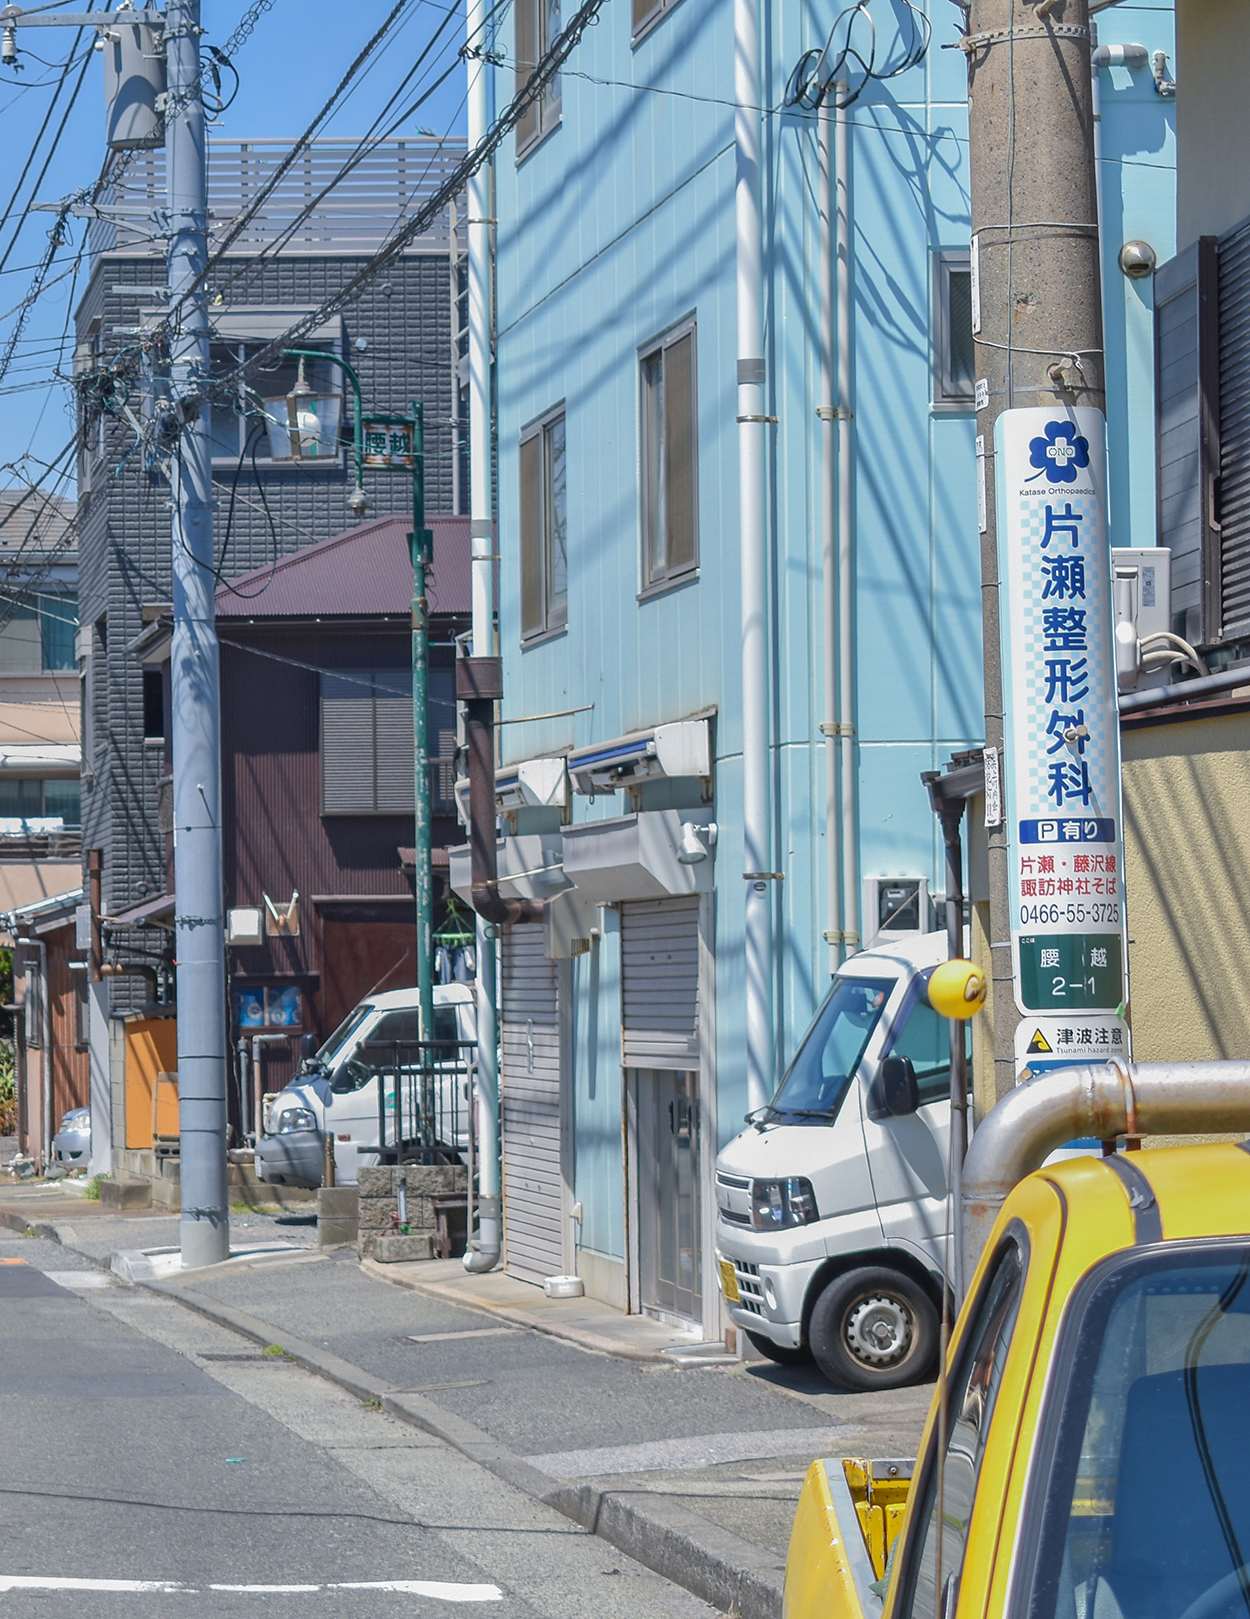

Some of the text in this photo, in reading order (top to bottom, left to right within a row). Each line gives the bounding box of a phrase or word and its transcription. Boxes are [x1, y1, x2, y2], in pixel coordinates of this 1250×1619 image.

[365, 432, 411, 456] 腰越
[1048, 447, 1074, 456] ONO
[1048, 487, 1096, 496] Orthopaedics
[1039, 503, 1092, 806] 片瀬整形外科
[1020, 854, 1117, 875] 片瀬・藤沢線
[1020, 877, 1117, 897] 諏訪神社そば
[1020, 903, 1119, 924] 0466-55-3725
[1051, 976, 1096, 996] 2-1
[1056, 1027, 1123, 1045] 津波注意
